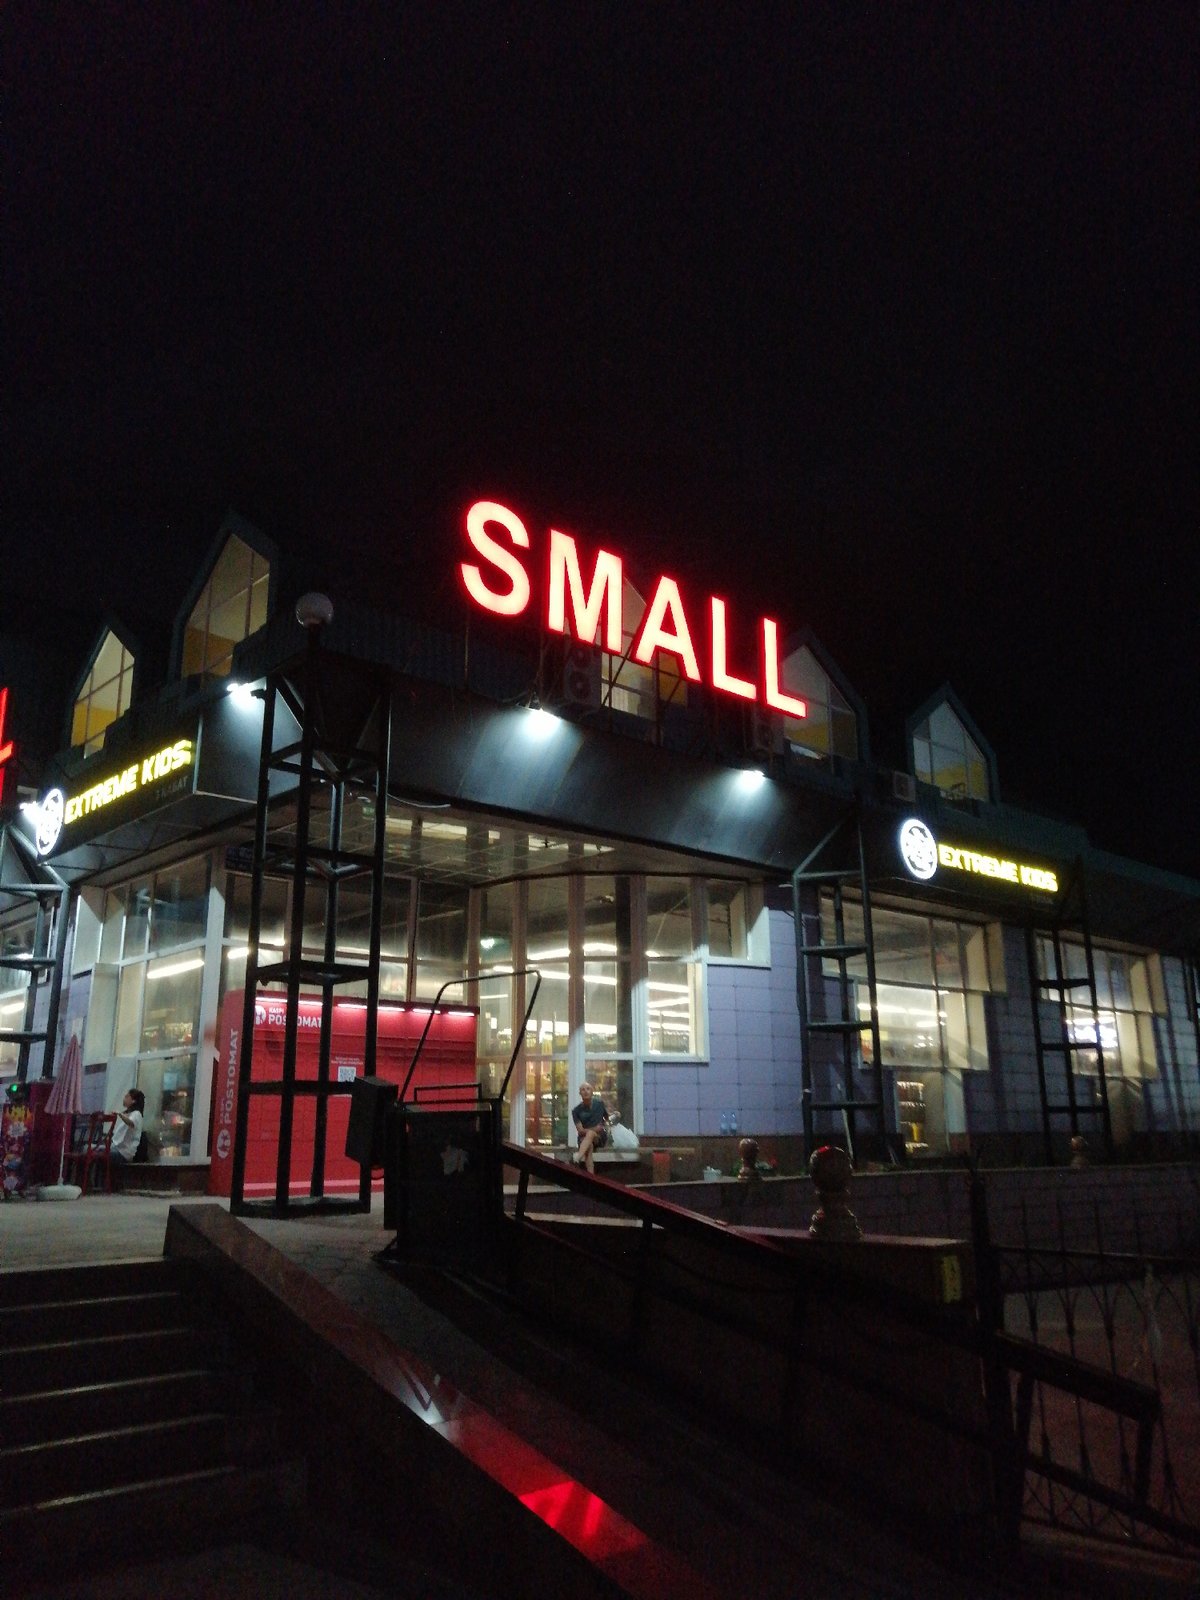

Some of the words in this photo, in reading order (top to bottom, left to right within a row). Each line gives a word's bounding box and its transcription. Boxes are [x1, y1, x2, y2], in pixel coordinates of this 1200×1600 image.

[460, 501, 807, 718] SMALL
[64, 764, 139, 825] EXTREME
[141, 740, 191, 785] KIDS
[937, 843, 1019, 883] EXTREME
[1021, 864, 1058, 892] KIDS
[268, 1014, 322, 1028] POSOMAT
[223, 1028, 239, 1124] POSTOMAT
